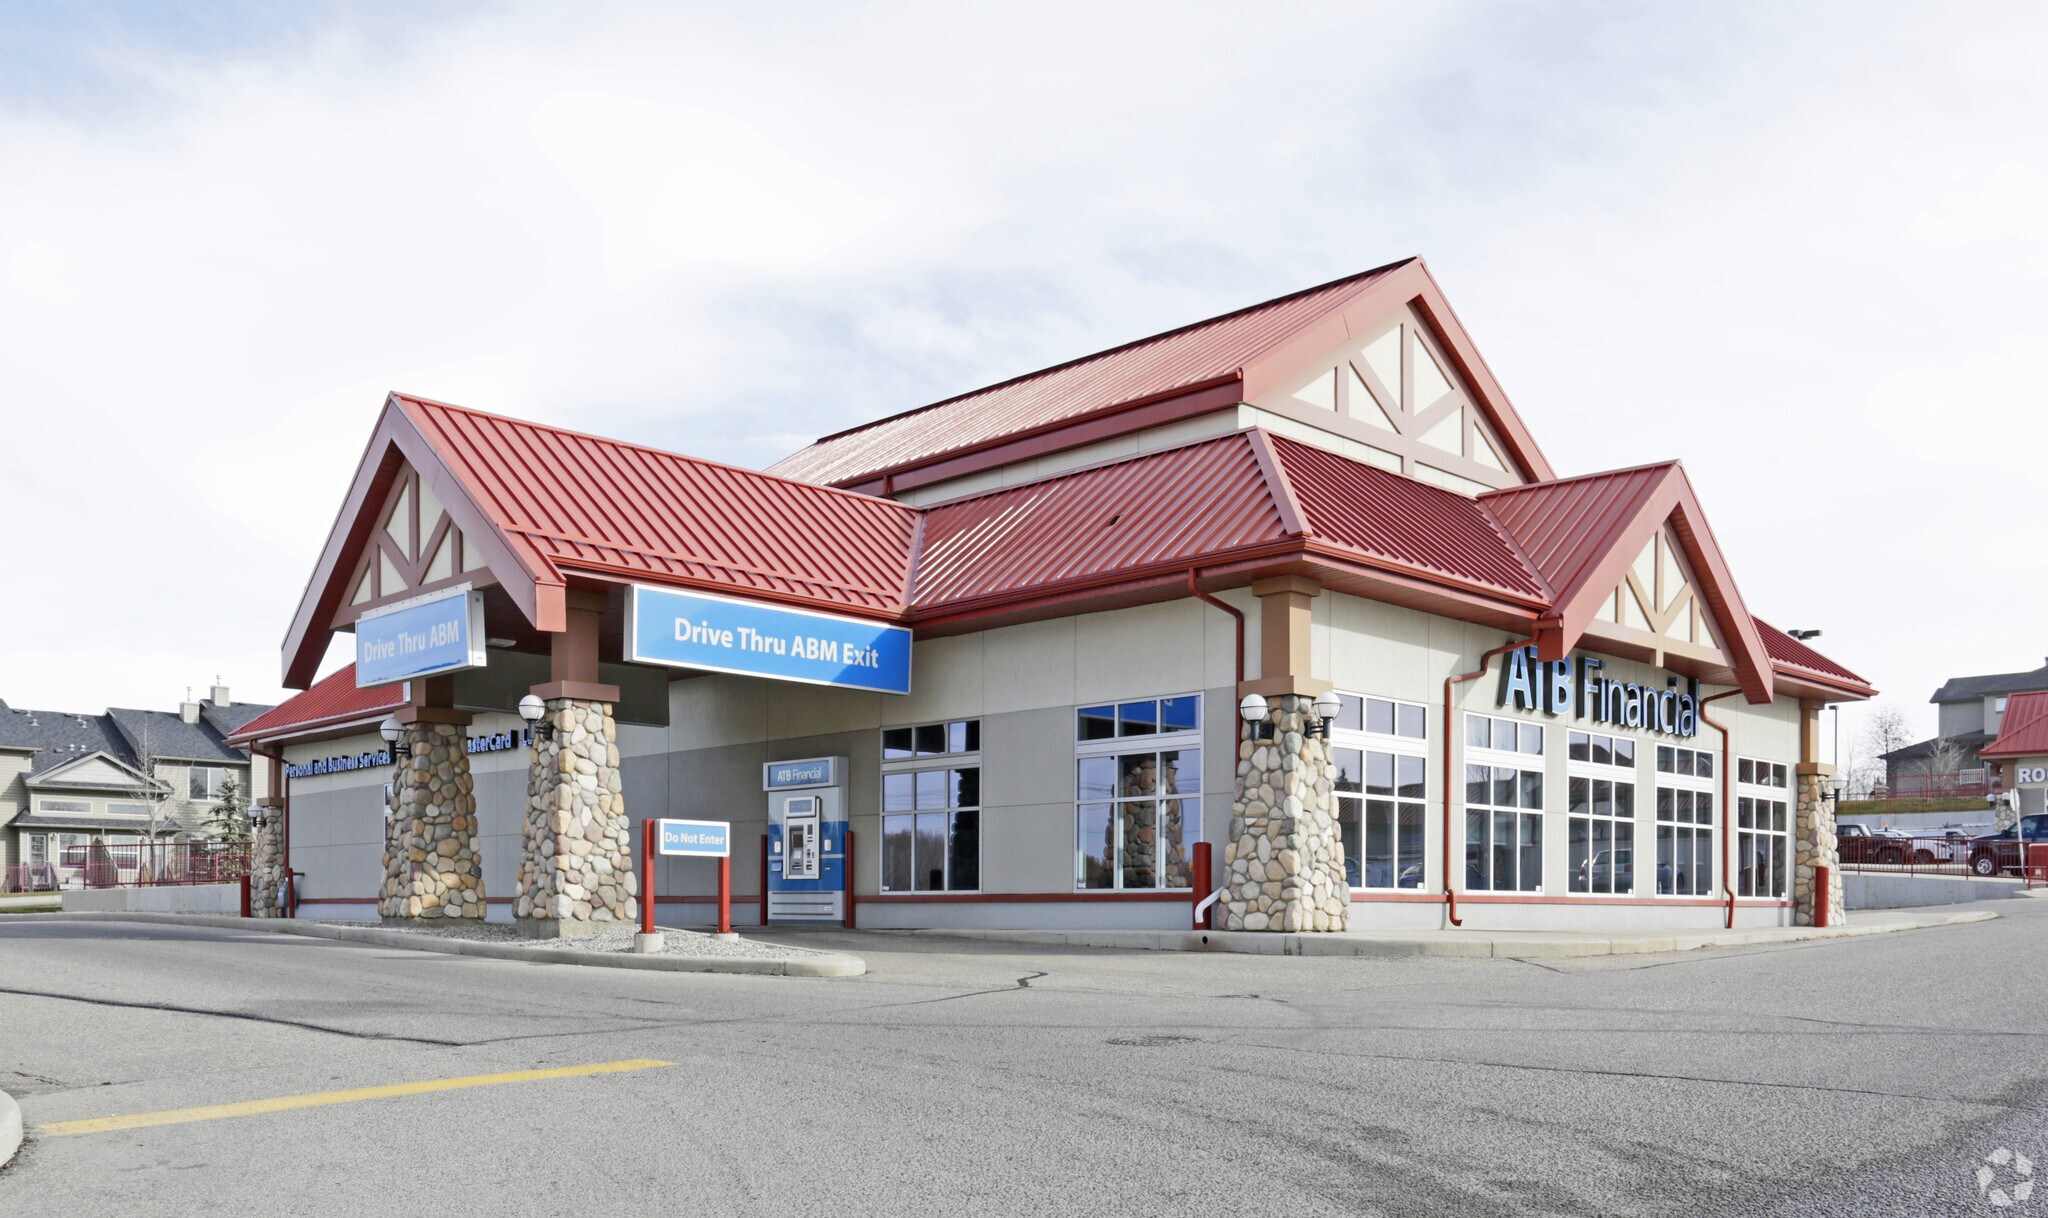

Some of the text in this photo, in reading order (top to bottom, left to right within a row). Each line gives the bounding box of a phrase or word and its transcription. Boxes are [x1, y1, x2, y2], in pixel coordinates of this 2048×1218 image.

[364, 619, 459, 664] Drive Thru ABM
[674, 617, 879, 668] Drive Thru ABM Exit
[1503, 645, 1700, 738] ATB Financial
[285, 762, 313, 778] Personal
[314, 758, 327, 774] and
[328, 756, 358, 773] Business
[359, 752, 391, 768] Services
[467, 729, 512, 753] asterCard
[777, 766, 822, 782] ATB Financial
[2018, 767, 2048, 783] RO
[664, 831, 724, 845] Do Not Enter
